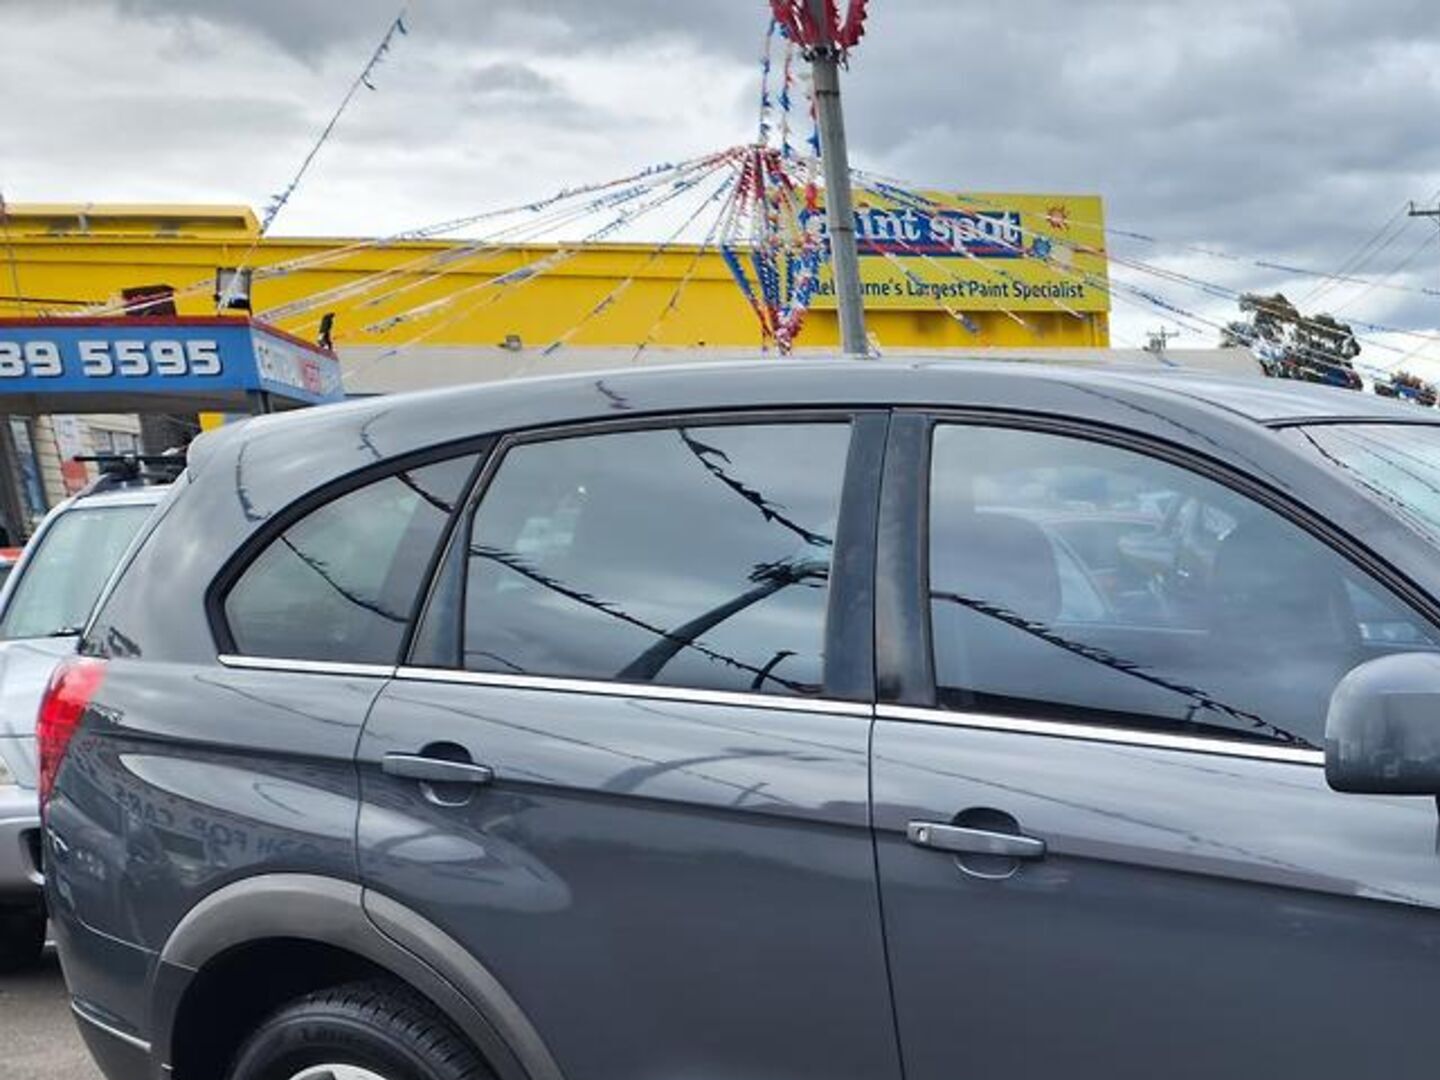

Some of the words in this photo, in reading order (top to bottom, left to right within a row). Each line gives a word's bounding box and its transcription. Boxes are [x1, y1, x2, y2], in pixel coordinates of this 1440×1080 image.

[930, 210, 1018, 252] spot
[907, 280, 963, 301] Largest
[968, 280, 1008, 296] Paint
[1013, 280, 1084, 300] Specialist
[78, 339, 222, 376] 5595
